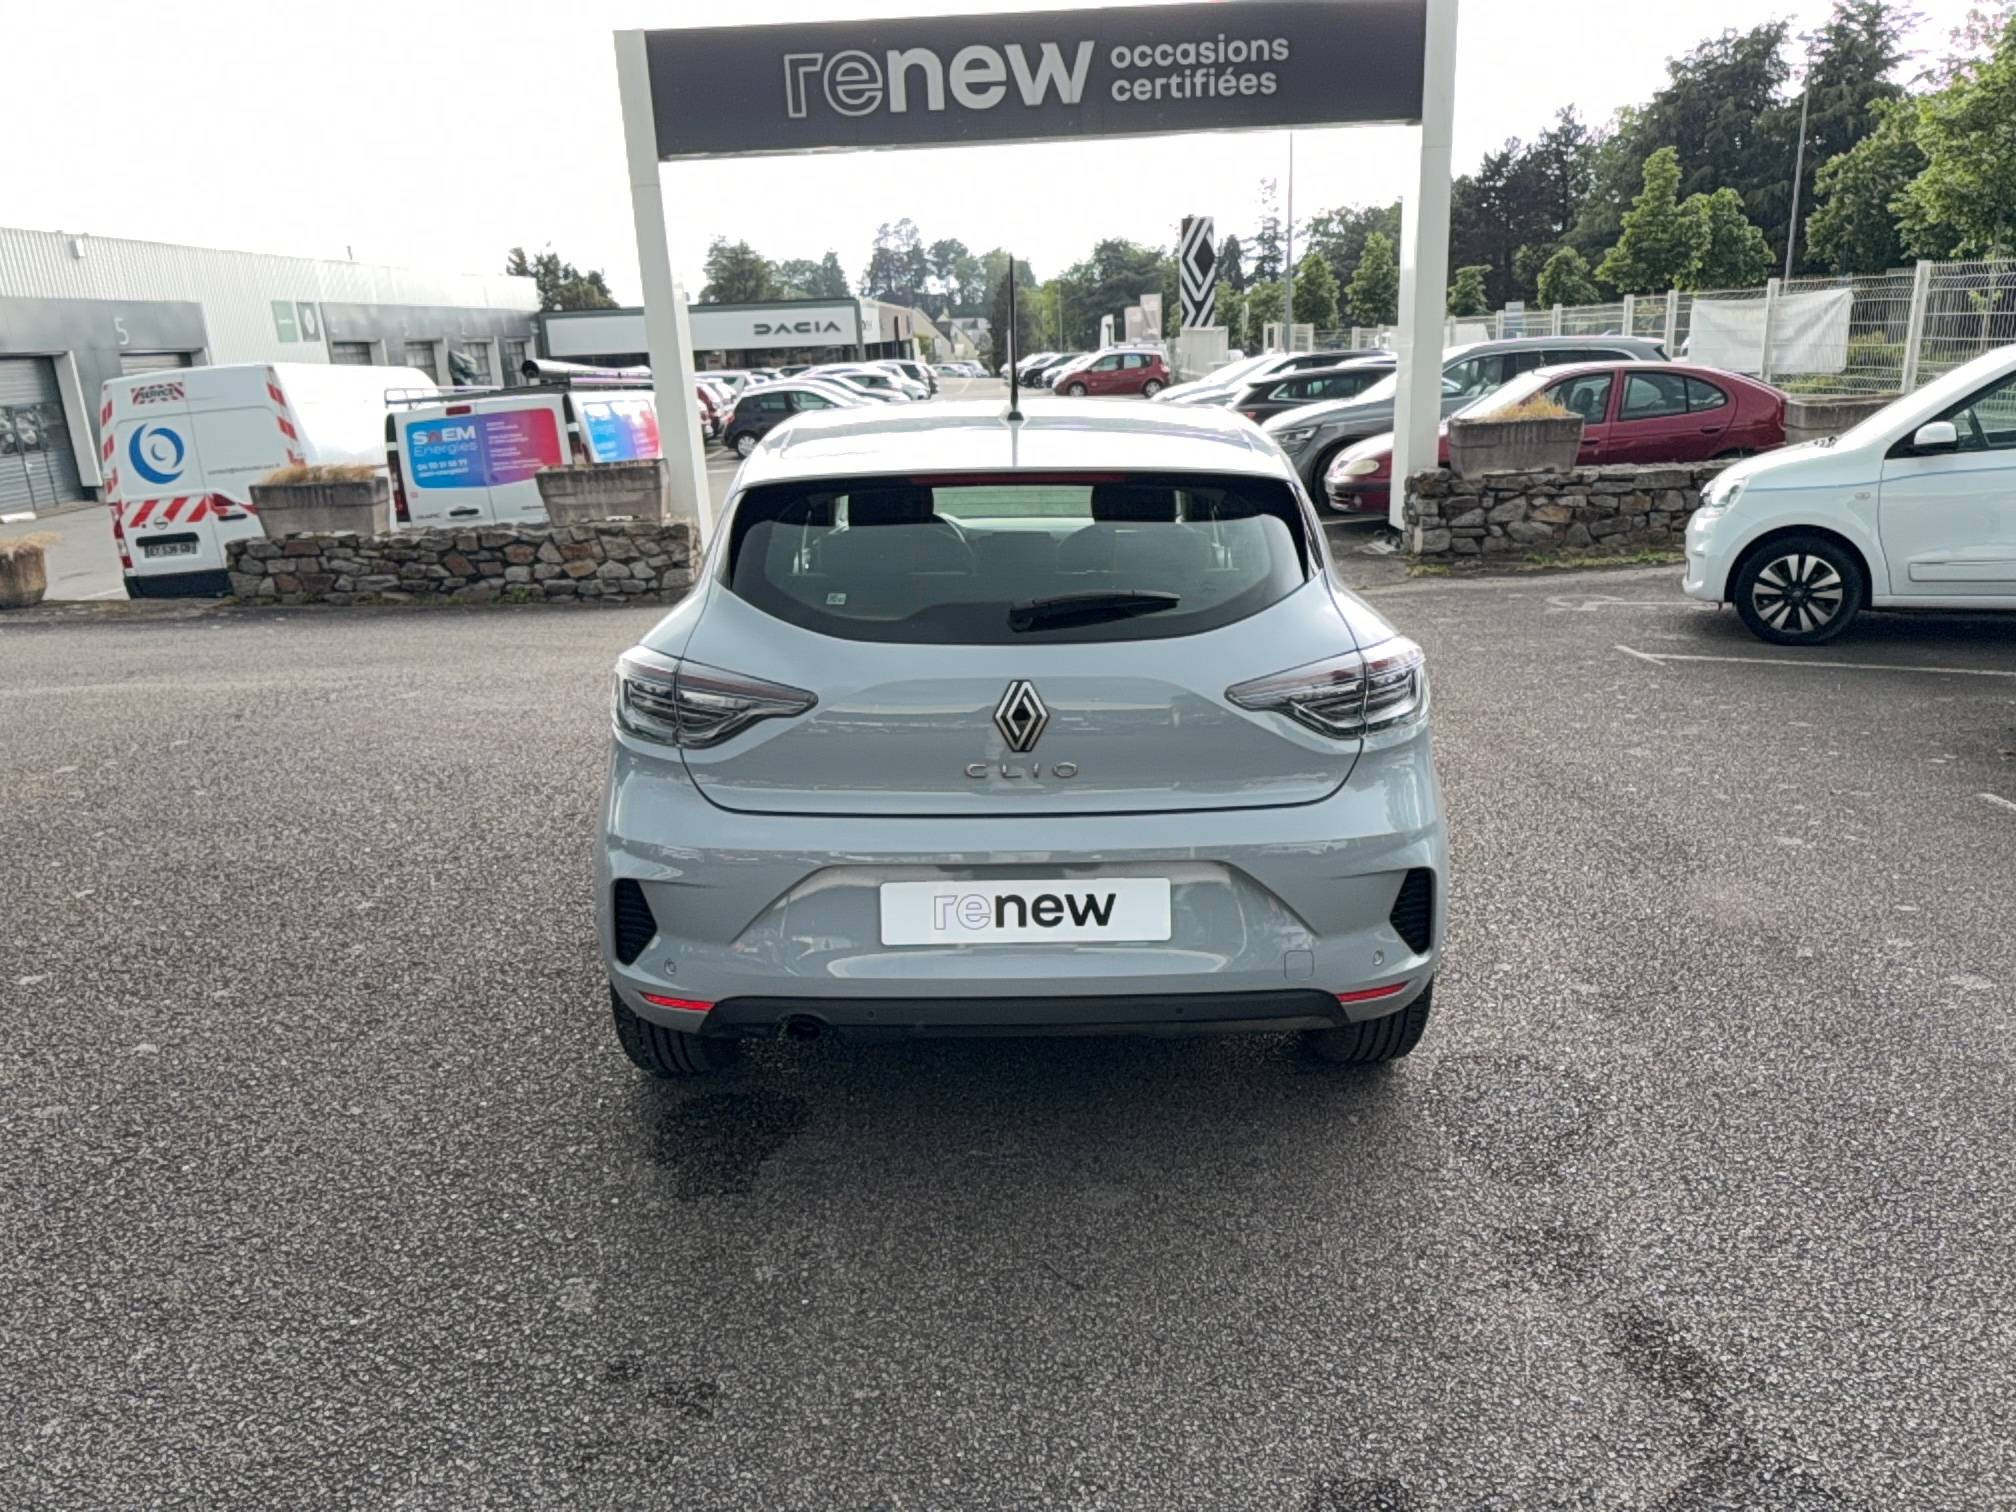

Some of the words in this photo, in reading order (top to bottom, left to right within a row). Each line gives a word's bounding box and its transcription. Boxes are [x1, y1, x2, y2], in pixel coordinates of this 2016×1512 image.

[1110, 34, 1289, 70] occasions
[783, 41, 1095, 118] renew
[1111, 66, 1278, 101] certifiées
[113, 316, 130, 346] 5
[753, 320, 842, 336] DACIA
[965, 762, 1079, 778] CLIO
[933, 892, 1117, 930] renew
